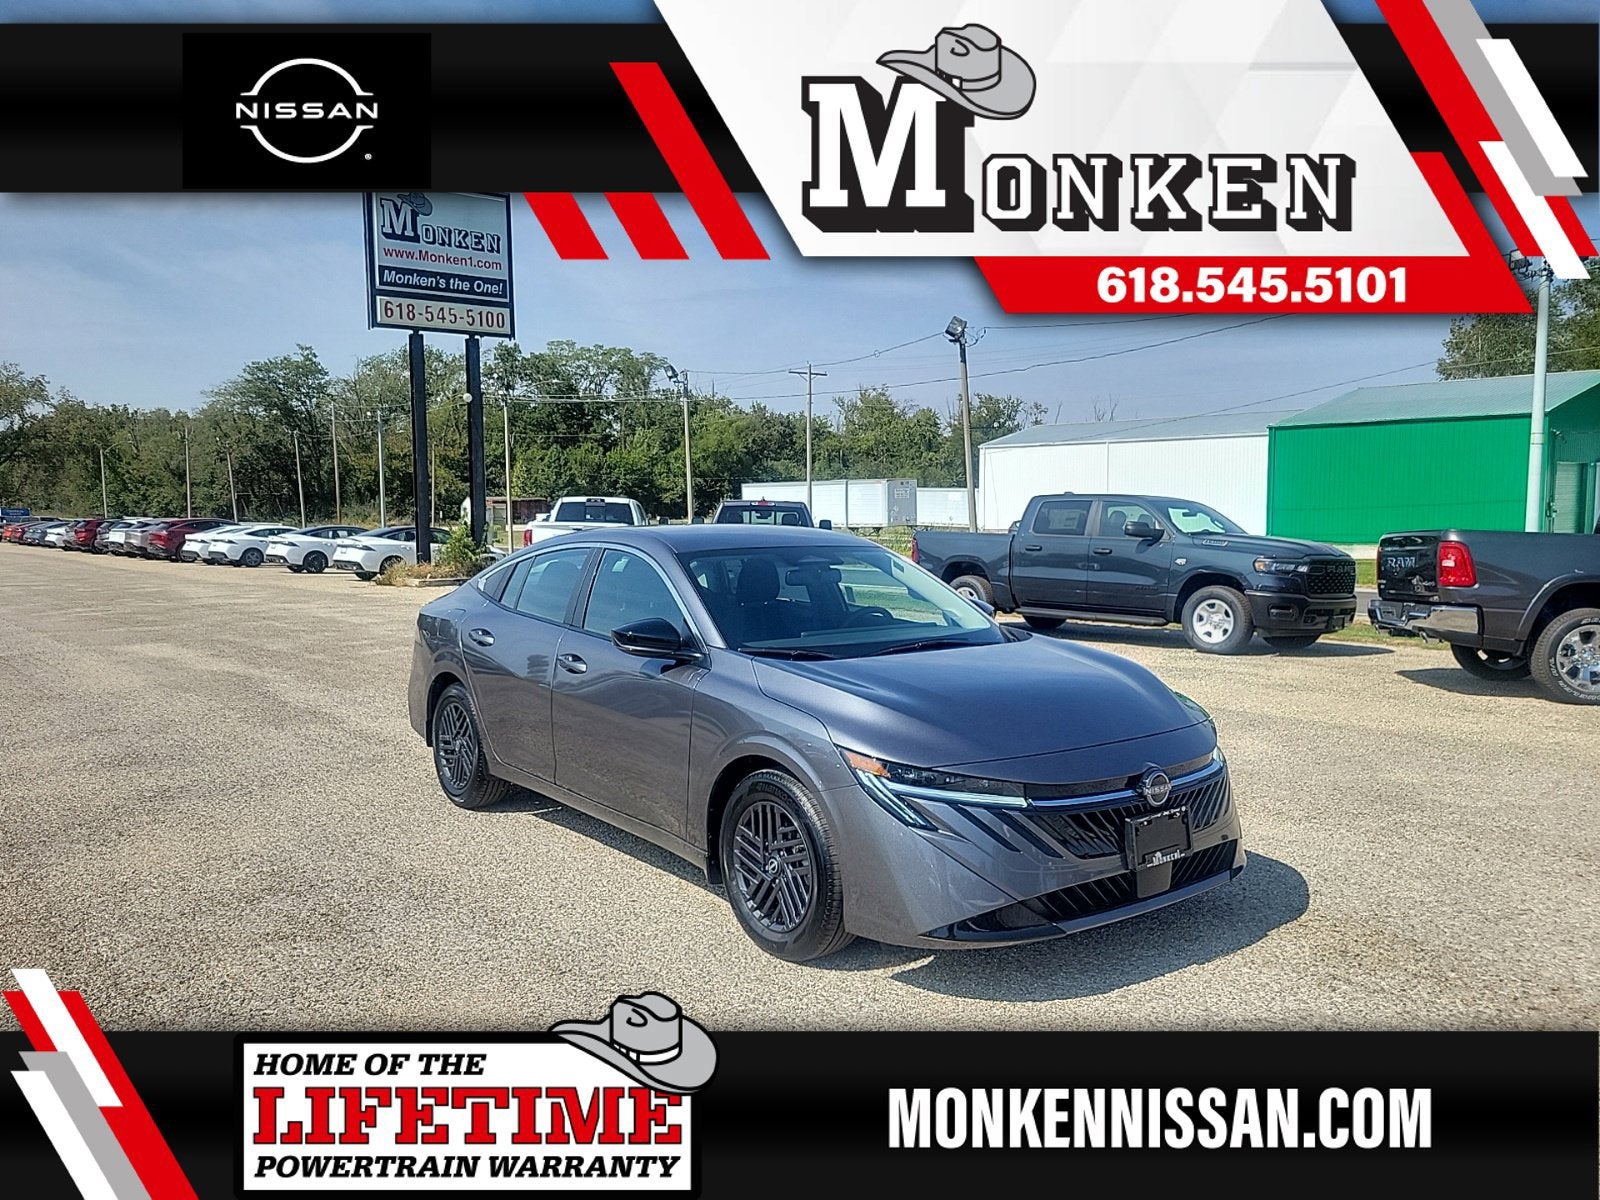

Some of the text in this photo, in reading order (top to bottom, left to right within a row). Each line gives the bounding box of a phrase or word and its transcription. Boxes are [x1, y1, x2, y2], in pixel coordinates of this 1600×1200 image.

[380, 197, 501, 254] MONKEN
[383, 247, 502, 270] www.Monken1.com
[383, 269, 503, 294] Monken's the One!
[384, 300, 505, 329] 618-545-5100
